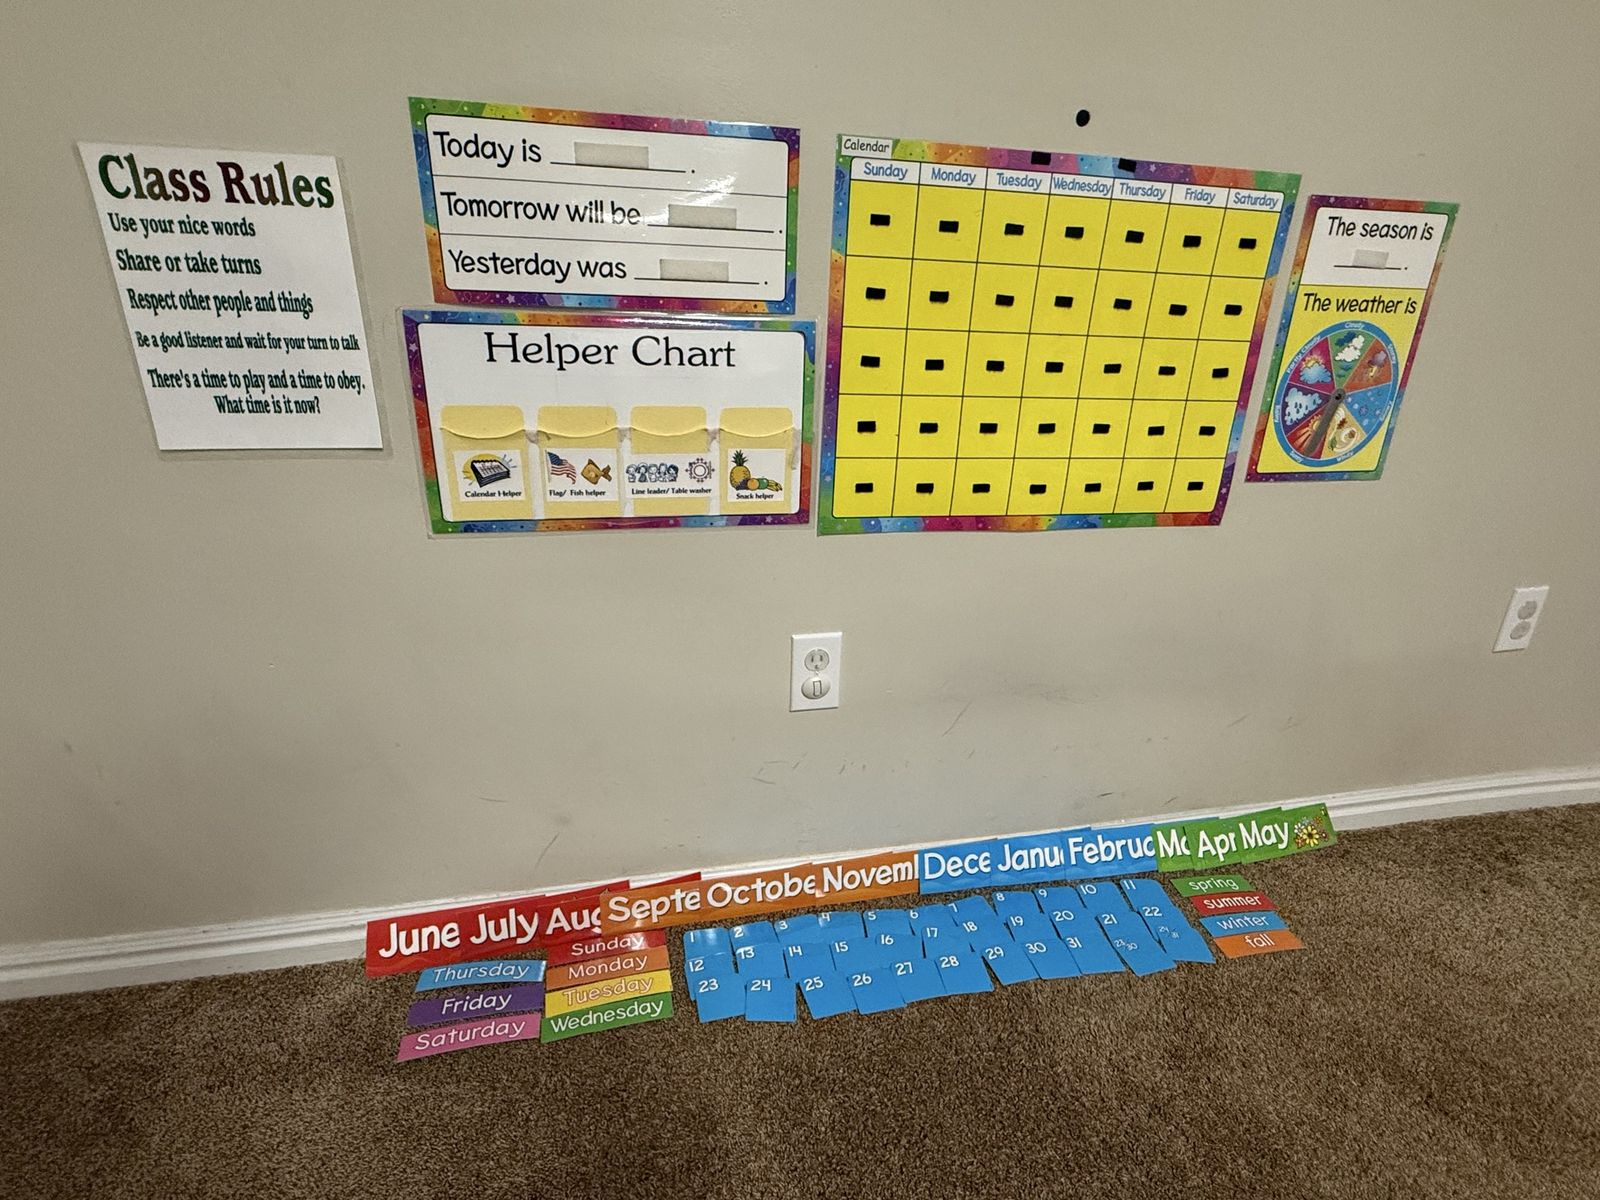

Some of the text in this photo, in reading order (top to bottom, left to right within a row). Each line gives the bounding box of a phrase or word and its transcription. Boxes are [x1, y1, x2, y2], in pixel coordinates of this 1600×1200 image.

[433, 130, 542, 168] Today is
[843, 139, 890, 153] Calendar
[863, 162, 908, 180] Sunday
[931, 167, 976, 185] Monday
[98, 153, 335, 208] Class Rules
[996, 173, 1042, 190] Tuesday
[1053, 177, 1112, 195] Wednesday
[1119, 182, 1166, 200] Thursday
[1184, 187, 1216, 204] Friday
[1233, 191, 1279, 208] Saturday
[440, 191, 641, 226] Tomorrow will be
[107, 212, 256, 239] Use your nice words
[1328, 216, 1434, 241] The season is
[116, 248, 262, 275] Share or take turns
[448, 249, 627, 284] Yesterday was
[126, 288, 314, 319] Respect other people and things
[1302, 292, 1417, 314] The weather is
[135, 330, 360, 354] Be a good listener and wait for your turn to talk
[484, 331, 737, 371] Helper Chart
[147, 368, 366, 395] There's a time to play and a time to obey.
[213, 394, 321, 414] What time is it now?
[465, 490, 522, 498] Calendar Helper
[585, 489, 607, 498] helper
[755, 492, 774, 501] helper
[1238, 820, 1289, 850] May
[1080, 884, 1097, 895] 10
[1123, 880, 1136, 890] 11
[1188, 878, 1240, 893] spring
[996, 892, 1005, 901] 8
[1038, 888, 1047, 898] 9
[948, 903, 958, 913] 7
[1203, 895, 1262, 909] summer
[820, 911, 831, 922] 4
[868, 911, 877, 921] 5
[910, 909, 919, 919] 6
[1053, 910, 1074, 922] 20
[1101, 914, 1118, 924] 21
[1142, 906, 1163, 917] 22
[469, 908, 539, 945] July
[778, 920, 789, 930] 3
[963, 922, 978, 933] 18
[1010, 916, 1024, 927] 19
[1216, 915, 1270, 930] winter
[689, 931, 695, 943] 1
[733, 926, 744, 938] 2
[880, 934, 894, 945] 16
[926, 927, 938, 938] 17
[378, 922, 461, 959] June
[571, 936, 645, 956] Sunday
[835, 941, 849, 952] 15
[1025, 942, 1046, 954] 30
[1066, 938, 1082, 949] 31
[1245, 933, 1275, 948] fall
[739, 946, 755, 960] 13
[788, 945, 803, 957] 14
[985, 947, 1004, 960] 29
[568, 955, 648, 980] Monday
[688, 959, 705, 973] 12
[895, 962, 913, 975] 27
[940, 956, 960, 968] 28
[433, 963, 530, 982] Thursday
[852, 973, 872, 987] 26
[563, 977, 654, 1006] Tuesday
[698, 978, 719, 993] 23
[750, 979, 771, 992] 24
[804, 976, 825, 992] 25
[441, 994, 512, 1015] Friday
[550, 1000, 664, 1033] Wednesday
[415, 1021, 526, 1050] Saturday
